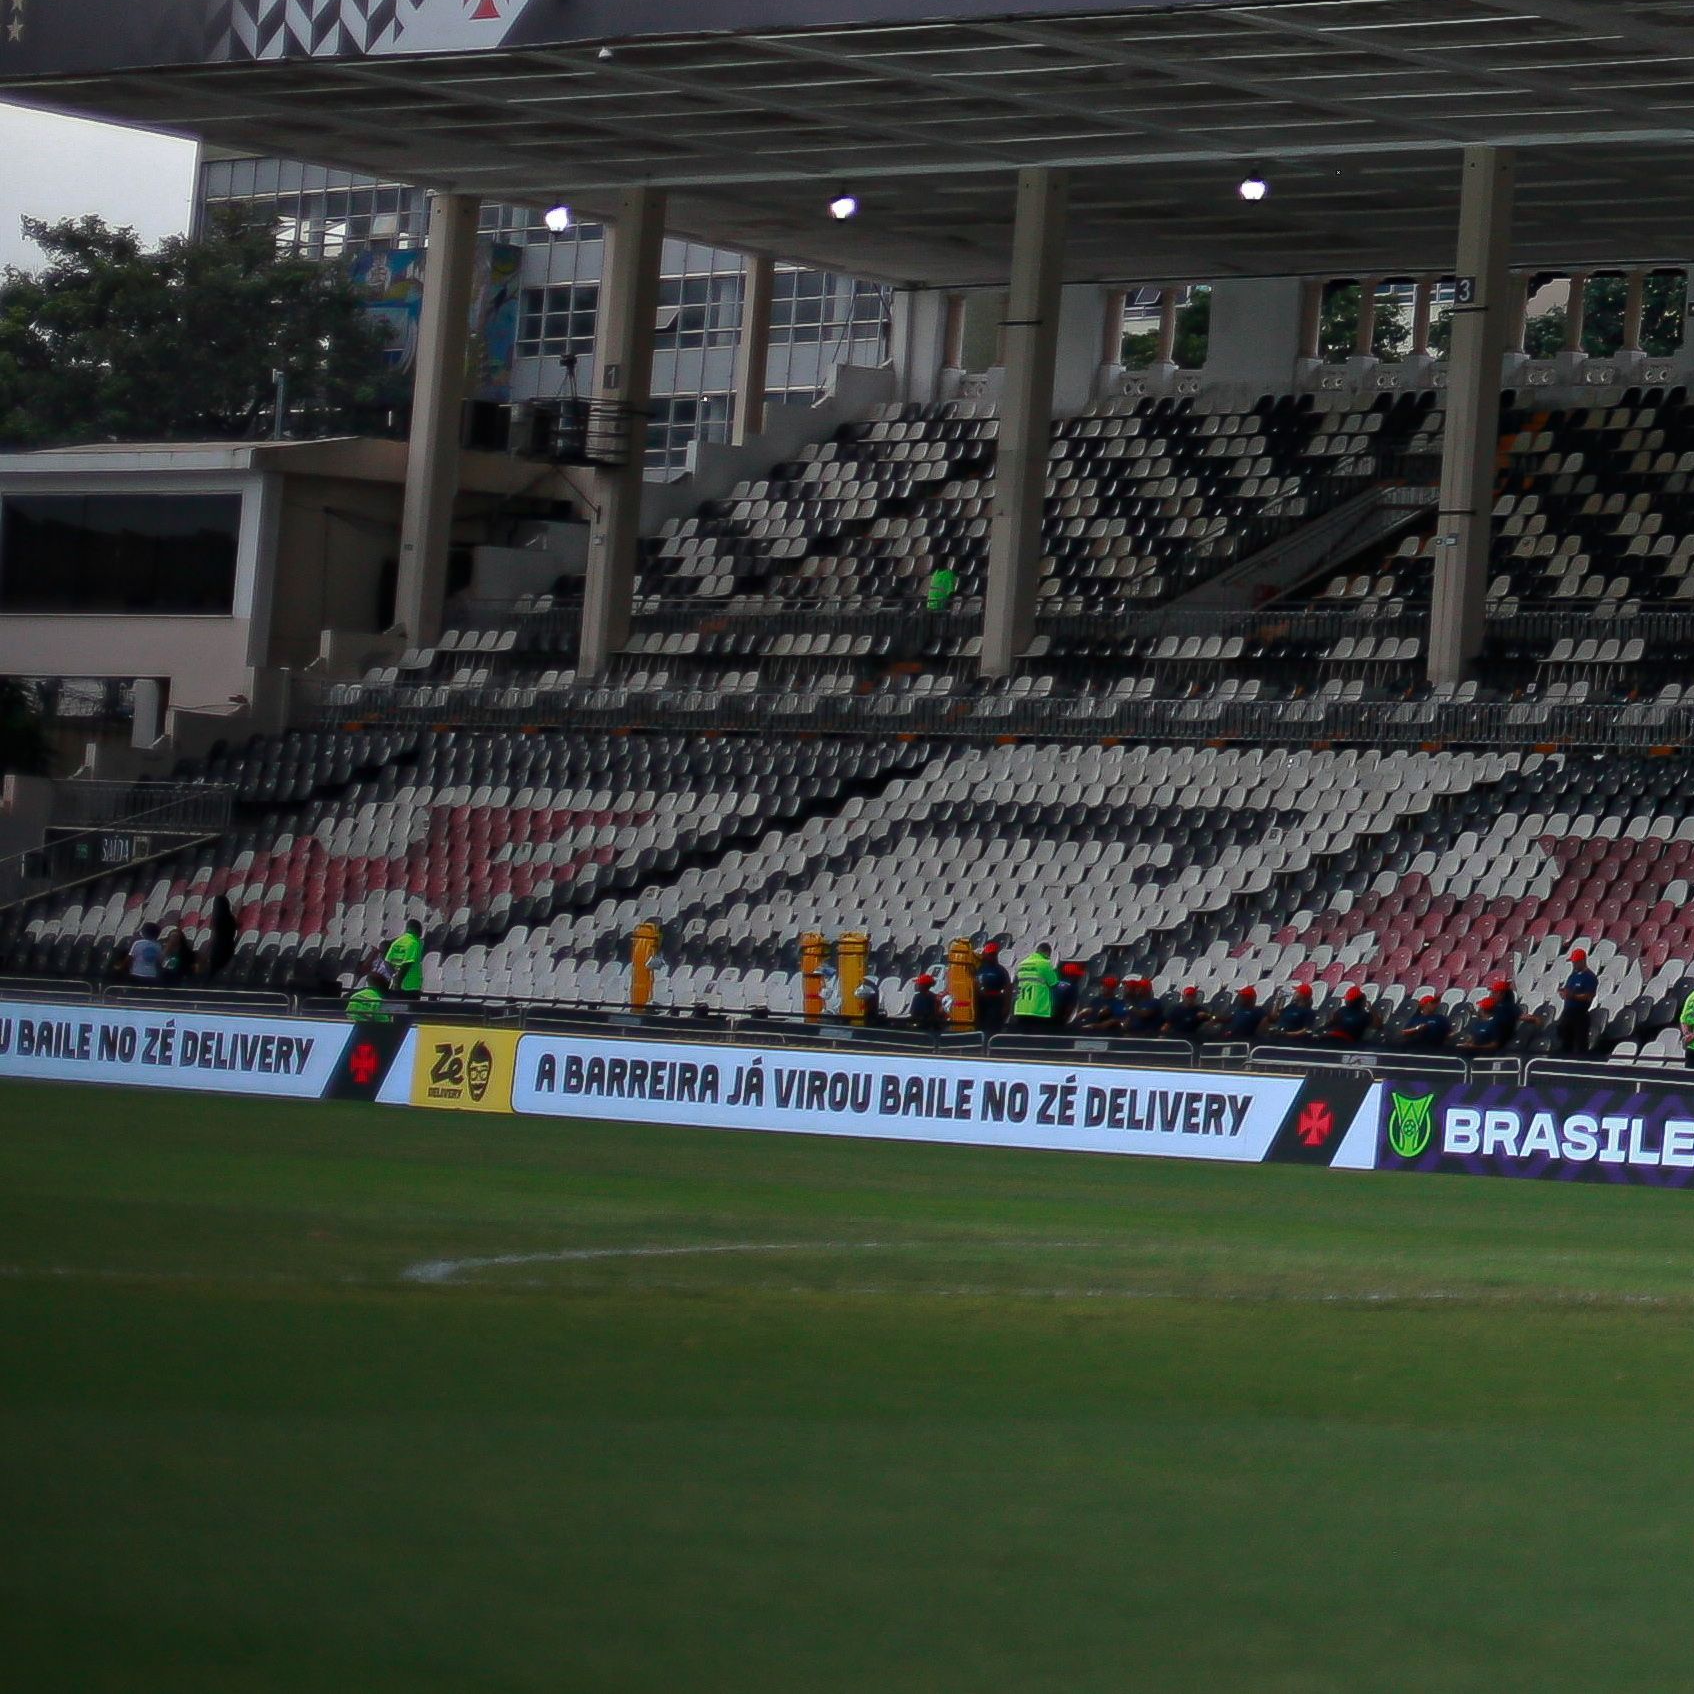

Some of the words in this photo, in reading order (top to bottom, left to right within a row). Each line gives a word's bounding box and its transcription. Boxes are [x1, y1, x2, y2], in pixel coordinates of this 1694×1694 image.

[16, 1019, 94, 1061] BAILE
[98, 1024, 138, 1064] NO
[140, 1018, 177, 1066] ZÉ
[179, 1029, 315, 1075] DELIVERY
[534, 1053, 556, 1093] A
[562, 1054, 719, 1105] BARREIRA
[726, 1055, 764, 1108] JÁ
[774, 1067, 873, 1114] VIROU
[879, 1073, 976, 1121] BAILE
[980, 1080, 1030, 1125] NO
[1036, 1074, 1080, 1127] ZÉ
[1084, 1085, 1254, 1137] DELIVERY
